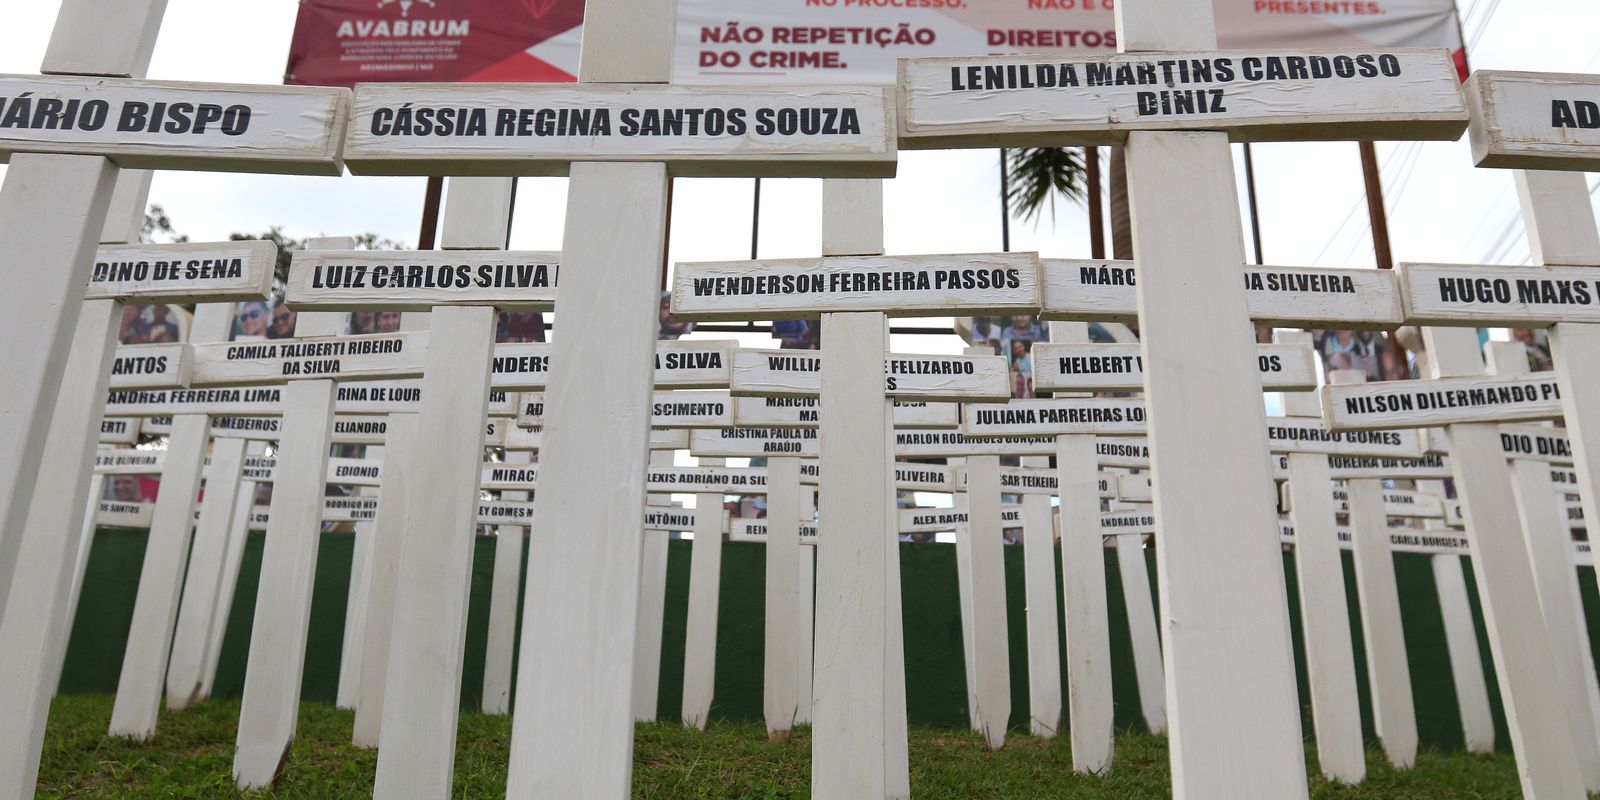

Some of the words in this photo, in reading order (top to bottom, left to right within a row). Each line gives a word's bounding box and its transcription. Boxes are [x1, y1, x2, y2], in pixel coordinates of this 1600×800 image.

[336, 20, 470, 38] AVABRUM
[701, 21, 764, 44] NÃO
[772, 23, 936, 48] REPETIÇÃO
[987, 29, 1117, 47] DIREITOS
[699, 51, 741, 68] DO
[749, 51, 847, 69] CRIME.
[951, 62, 1075, 91] LENILDA
[1086, 57, 1235, 88] MARTINS
[1241, 53, 1402, 82] CARDOSO
[1137, 88, 1227, 116] DINIZ
[0, 92, 109, 131] ÁRIO
[116, 101, 252, 136] BISPO
[370, 102, 486, 137] CÁSSIA
[494, 107, 609, 137] REGINA
[619, 107, 748, 137] SANTOS
[755, 107, 861, 136] SOUZA
[1551, 99, 1600, 129] AD
[93, 260, 149, 282] DINO
[153, 260, 181, 281] DE
[186, 257, 243, 280] SENA
[312, 265, 370, 288] LUIZ
[371, 264, 472, 288] CARLOS
[475, 264, 549, 288] SILVA
[693, 273, 824, 297] WENDERSON
[829, 270, 931, 293] FERREIRA
[935, 268, 1021, 291] PASSOS
[1080, 265, 1136, 287] MÁRC
[1268, 273, 1356, 294] SILVEIRA
[1438, 277, 1511, 304] HUGO
[1516, 279, 1592, 305] MAXS
[226, 343, 278, 361] CAMILA
[280, 340, 346, 358] TALIBERTI
[348, 339, 403, 355] RIBEIRO
[112, 356, 168, 375] ANTOS
[282, 361, 302, 375] DA
[303, 359, 341, 374] SILVA
[665, 351, 722, 370] SILVA
[891, 360, 974, 375] FELIZARDO
[1060, 356, 1133, 375] HELBERT
[170, 389, 240, 404] FERREIRA
[243, 388, 281, 403] LIMA
[337, 387, 367, 402] RINA
[370, 387, 386, 402] DE
[388, 387, 421, 402] LOUR
[1346, 393, 1413, 415] NILSON
[1416, 385, 1538, 410] DILERMANDO
[651, 403, 724, 416] SCIMENTO
[799, 410, 821, 422] MA
[976, 409, 1036, 425] JULIANA
[1039, 407, 1123, 424] PARREIRAS
[100, 421, 127, 434] ERTI
[220, 417, 278, 431] MEDEIROS
[334, 422, 387, 434] ELIANDRO
[721, 428, 769, 439] CRISTINA
[770, 428, 802, 439] PAULA
[803, 429, 817, 440] DA
[896, 433, 940, 445] MARLON
[1268, 426, 1342, 443] EDUARDO
[1344, 431, 1401, 446] GOMES
[763, 440, 802, 453] ARAÚJO
[1096, 443, 1140, 458] LEIDSON
[1501, 433, 1533, 454] DIO
[1381, 457, 1398, 469] DA
[335, 466, 379, 478] EDIONIO
[492, 468, 538, 482] MIRAC
[678, 473, 729, 485] ADRIANO
[732, 475, 747, 486] DA
[749, 475, 768, 486] SIL
[1000, 475, 1020, 487] SAR
[325, 500, 362, 510] RODRIGO
[491, 506, 525, 518] GOMES
[913, 515, 937, 526] ALEX
[1101, 516, 1140, 528] ANDRADE
